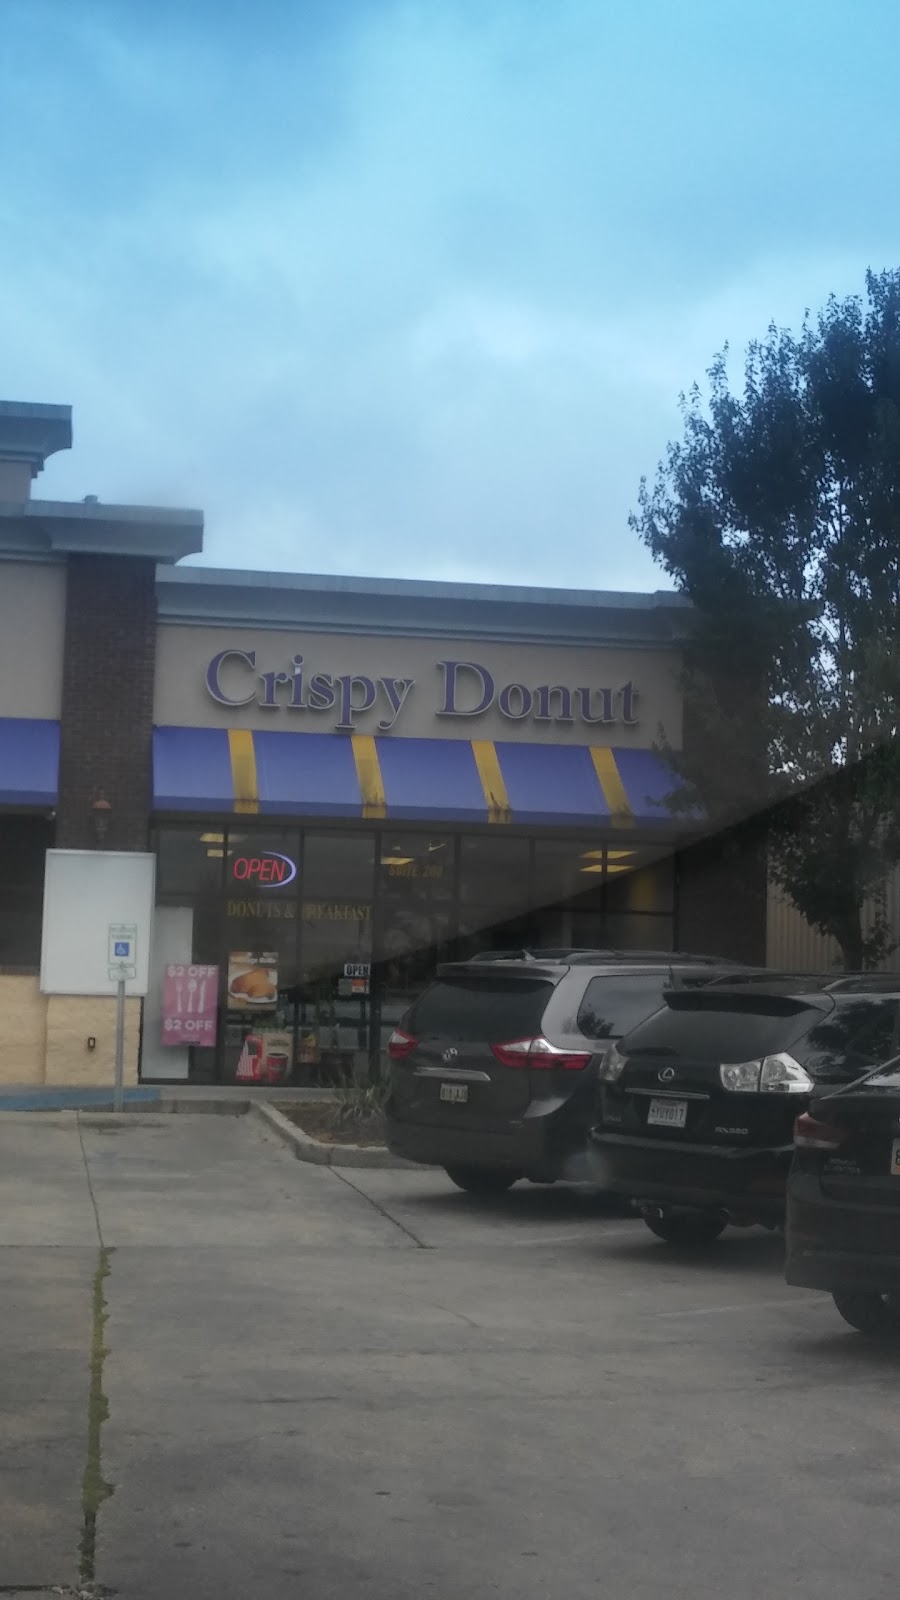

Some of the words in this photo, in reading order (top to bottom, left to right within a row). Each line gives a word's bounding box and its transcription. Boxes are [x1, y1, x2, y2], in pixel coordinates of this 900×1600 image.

[205, 648, 415, 732] Crispy
[435, 659, 640, 726] Donut
[232, 857, 286, 883] OPEN
[227, 900, 281, 919] DONUTS
[167, 965, 185, 978] $2
[188, 966, 217, 978] OFF
[346, 964, 369, 976] OPEN
[163, 1018, 182, 1032] $2
[185, 1019, 214, 1031] OFF
